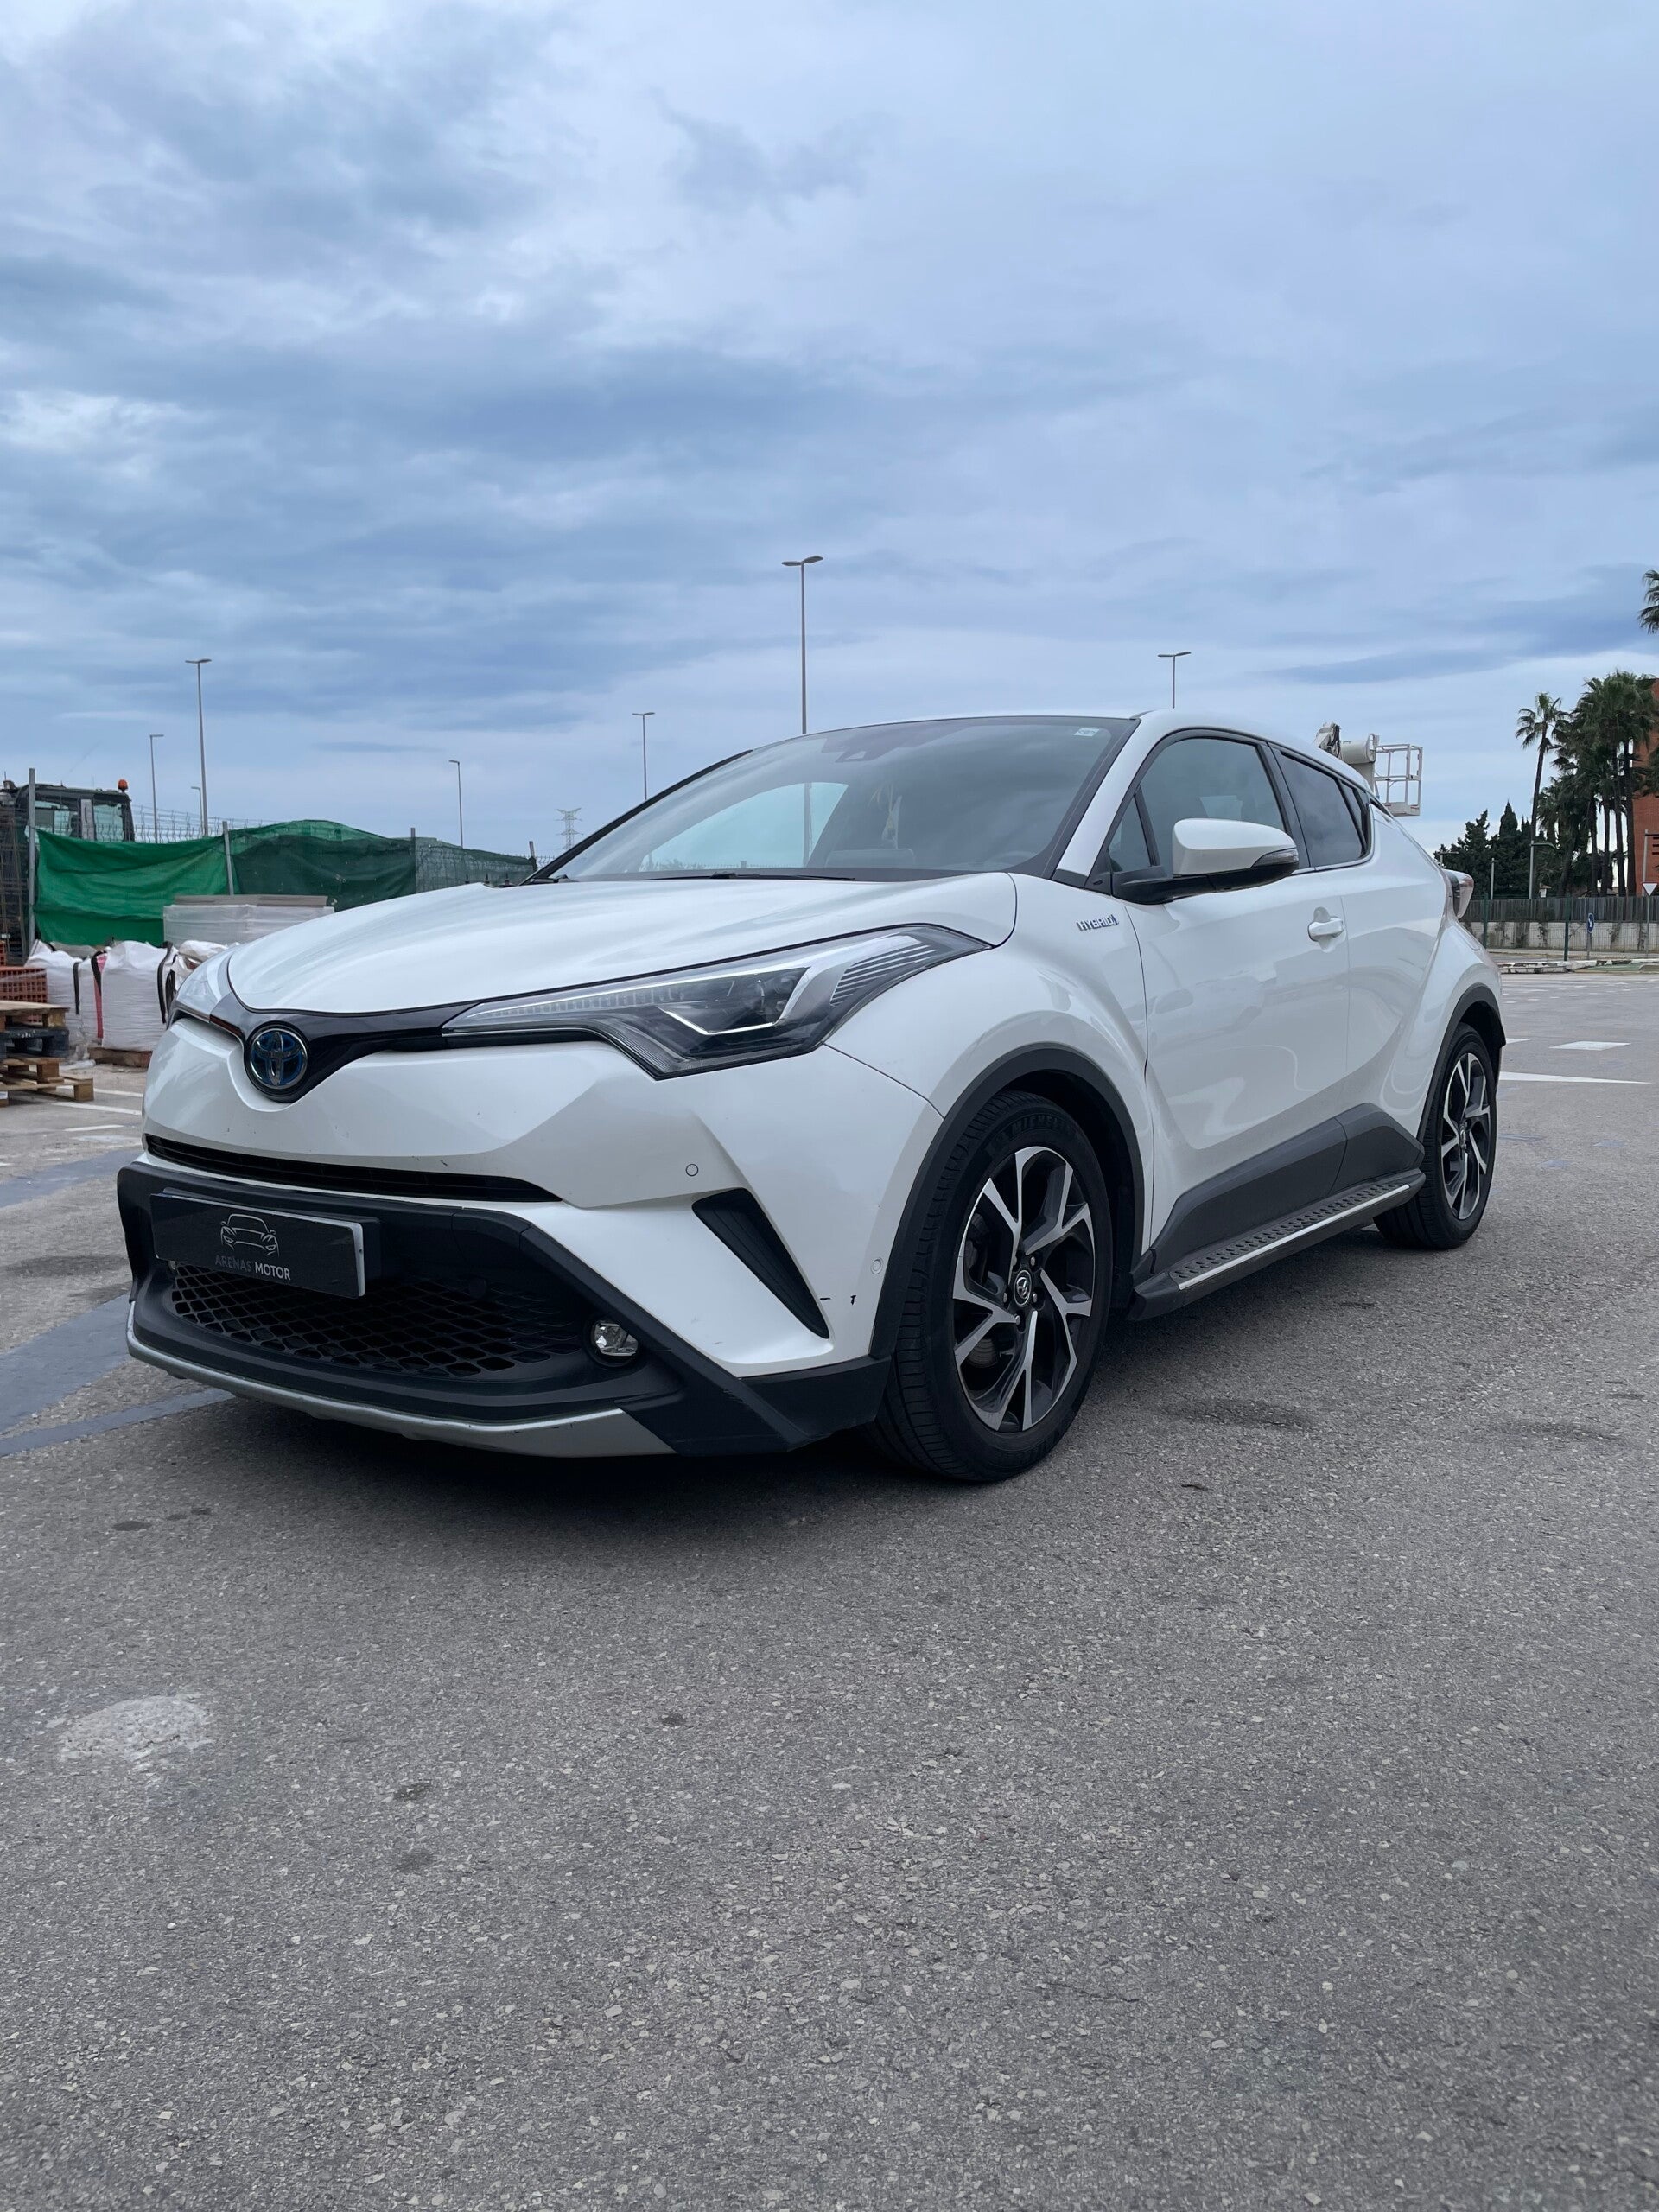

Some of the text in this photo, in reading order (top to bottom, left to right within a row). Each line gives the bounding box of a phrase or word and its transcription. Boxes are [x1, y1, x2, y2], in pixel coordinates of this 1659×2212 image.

[1077, 914, 1118, 931] HYBRID
[215, 1255, 291, 1281] ARENAS MOTOR
